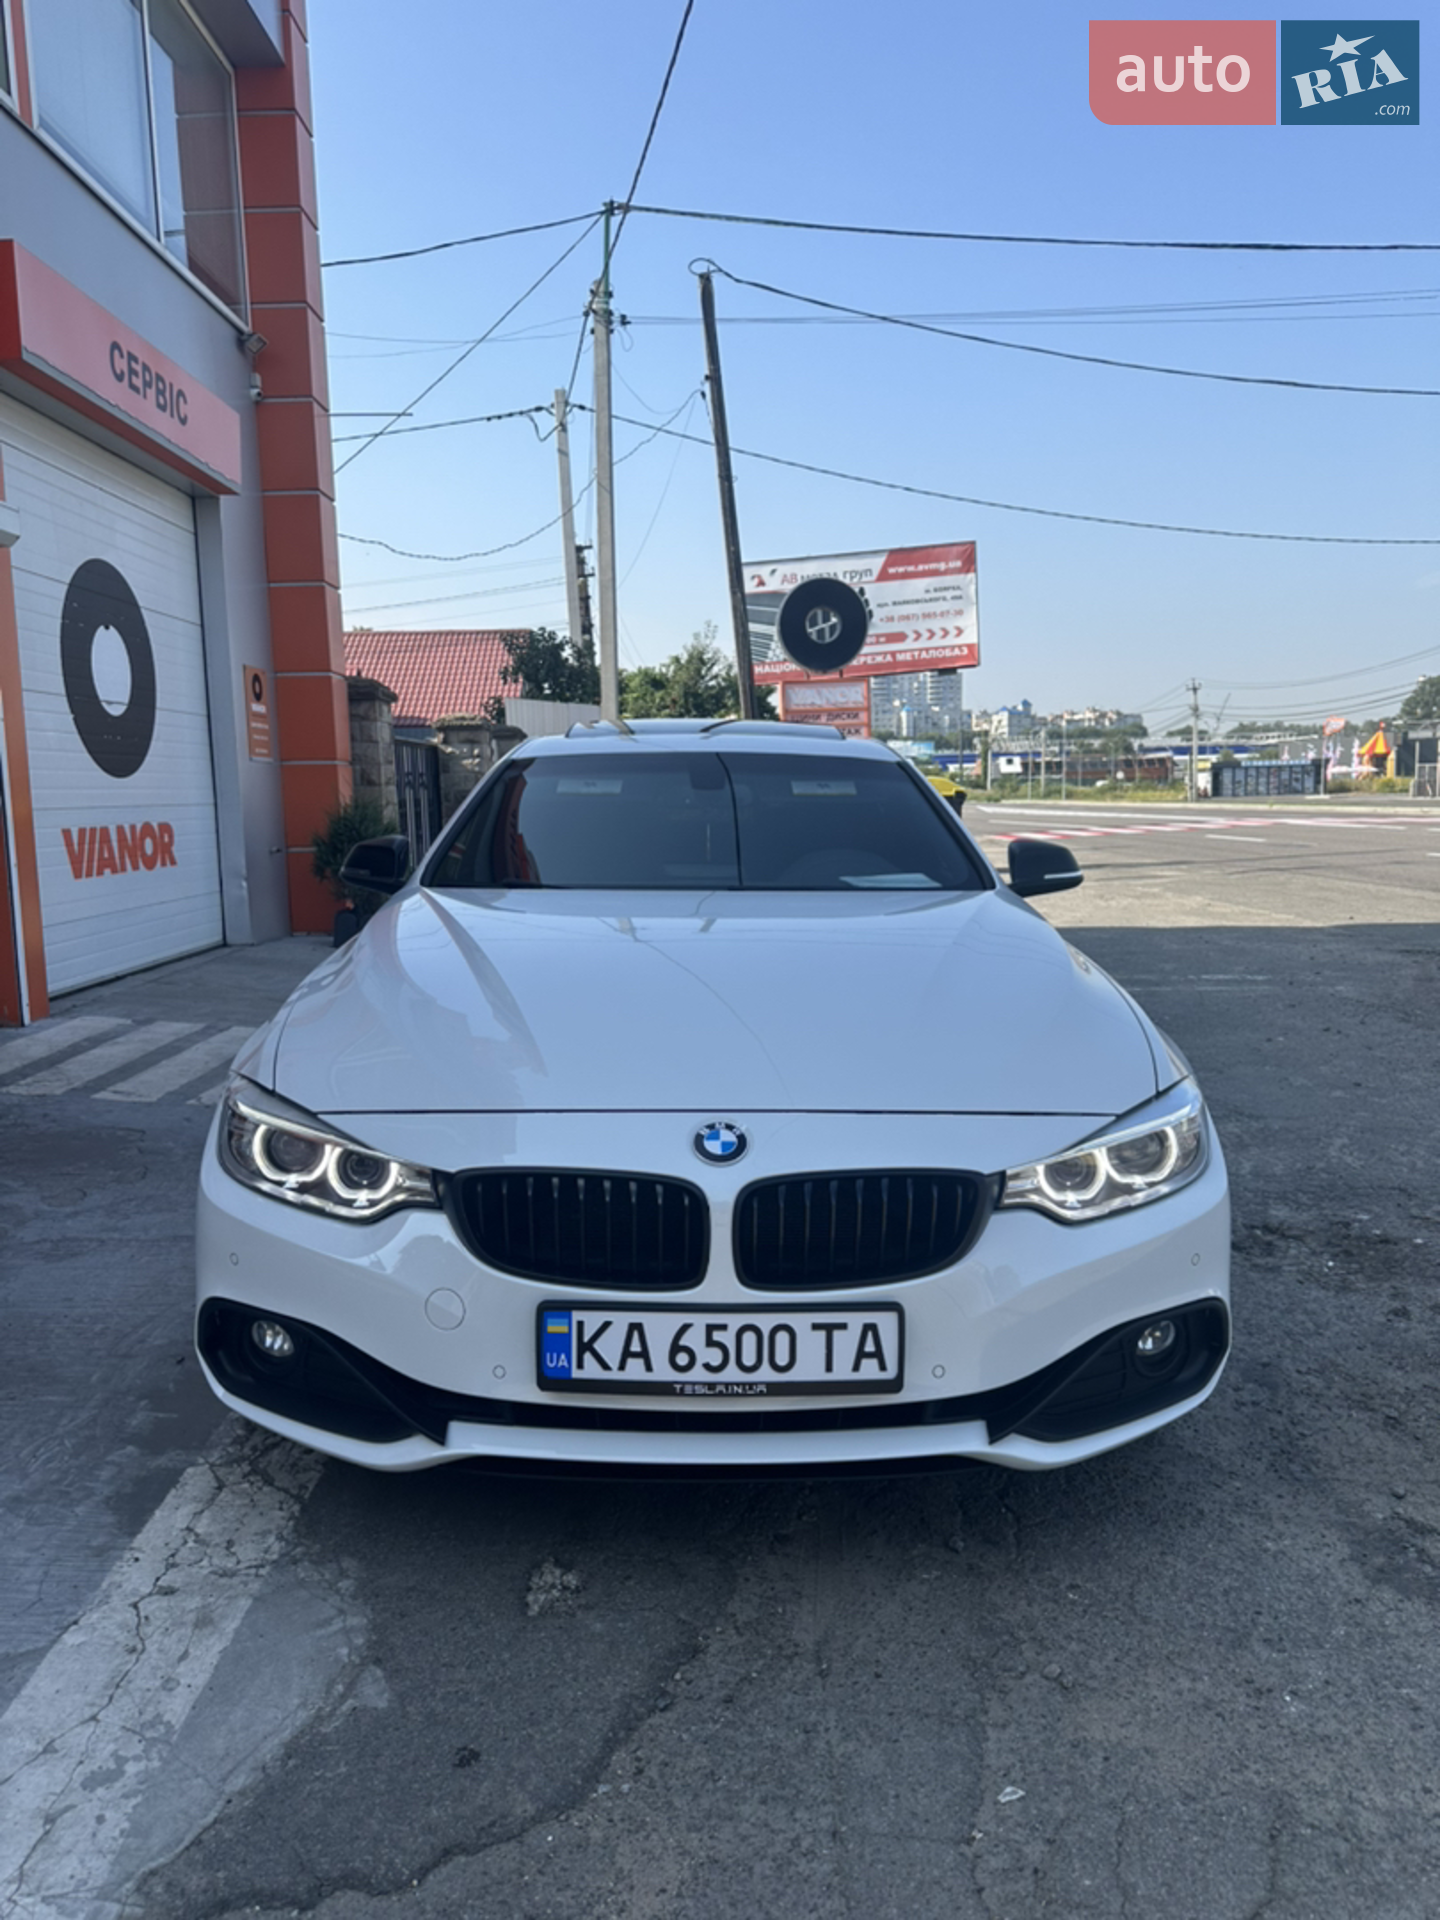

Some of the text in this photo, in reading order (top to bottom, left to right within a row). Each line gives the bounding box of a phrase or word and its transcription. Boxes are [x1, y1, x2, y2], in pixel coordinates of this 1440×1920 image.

[108, 339, 189, 428] СЕРВІС
[842, 568, 874, 583] груп
[849, 654, 893, 667] ЕРЕЖА
[896, 646, 969, 662] МЕТАЛОБАЗ
[826, 711, 860, 722] ДИСКИ
[61, 820, 178, 881] VIANOR
[546, 1320, 888, 1374] UA KA 6500 TA
